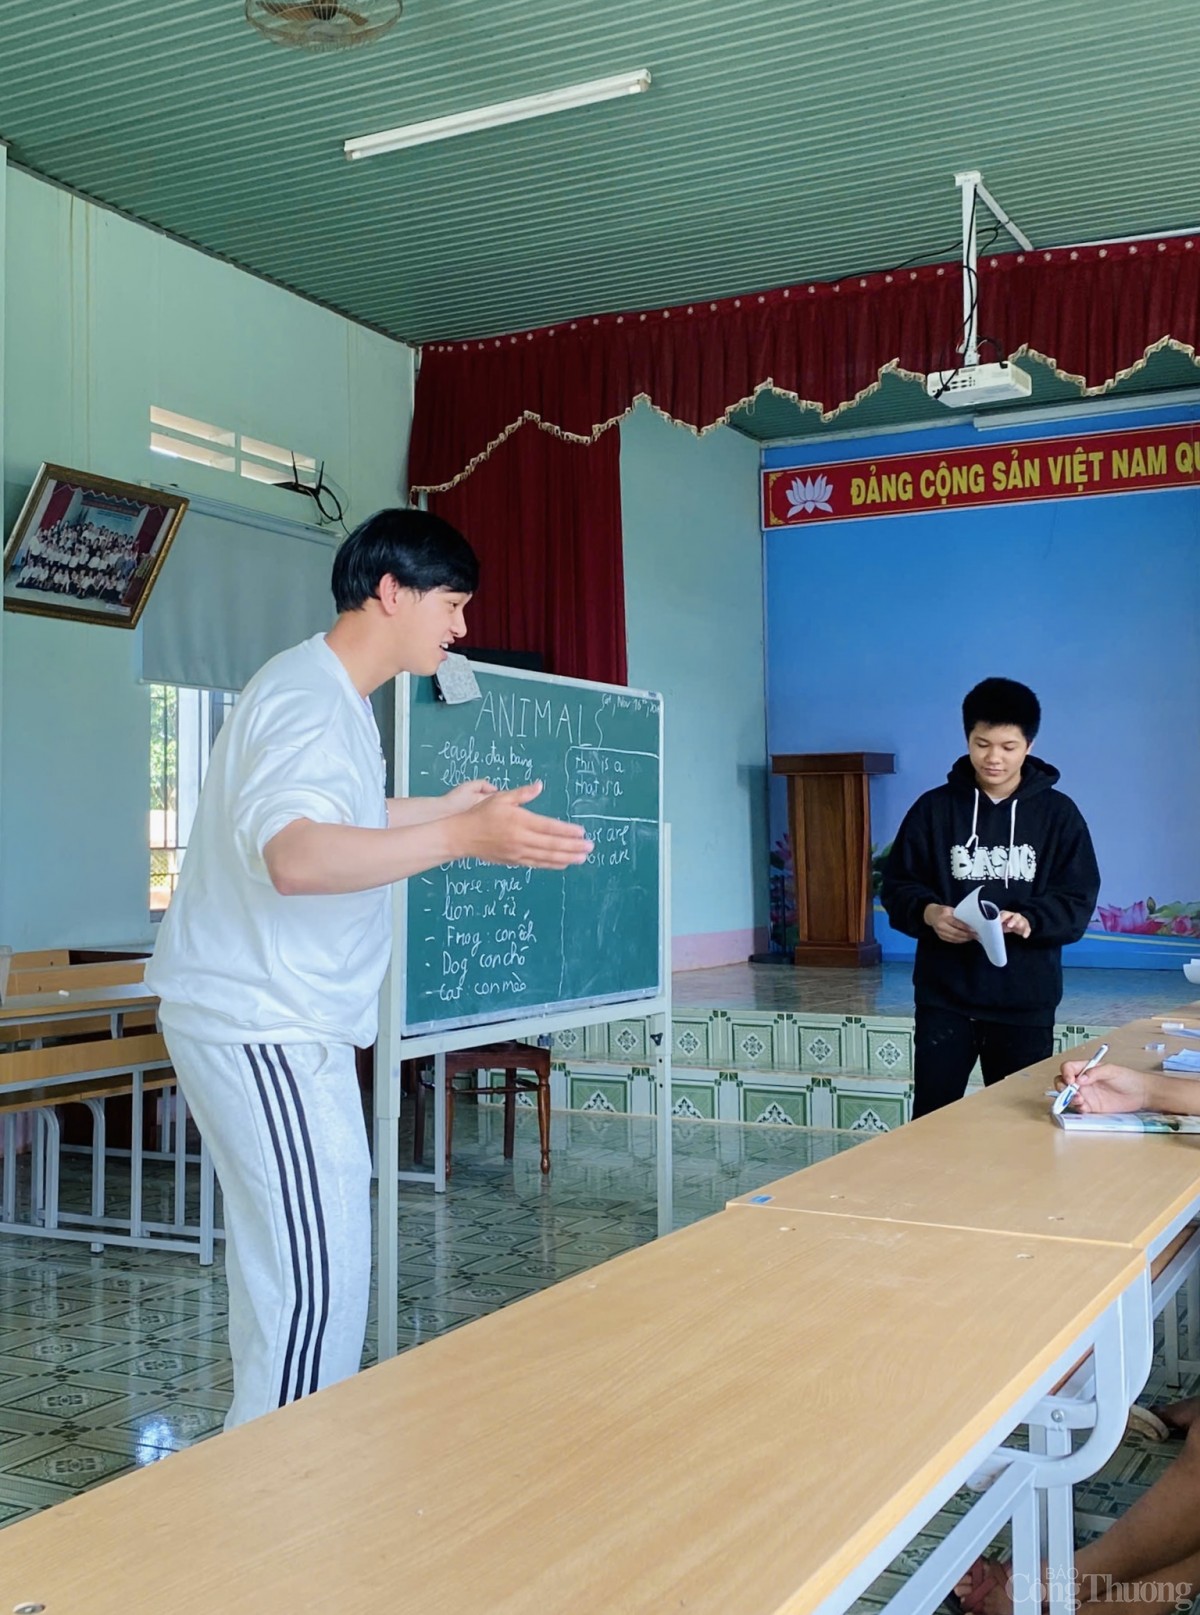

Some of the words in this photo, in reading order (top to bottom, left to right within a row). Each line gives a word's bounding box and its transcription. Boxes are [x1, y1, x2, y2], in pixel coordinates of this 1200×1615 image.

[851, 465, 914, 506] ĐẢNG
[920, 461, 985, 505] CỘNG
[992, 449, 1041, 491] SẢN
[1048, 446, 1104, 492] VIỆT
[1111, 445, 1168, 480] NAM
[475, 690, 604, 751] ANIMALS
[614, 760, 624, 773] a
[613, 781, 623, 796] a
[442, 951, 468, 987] Dog
